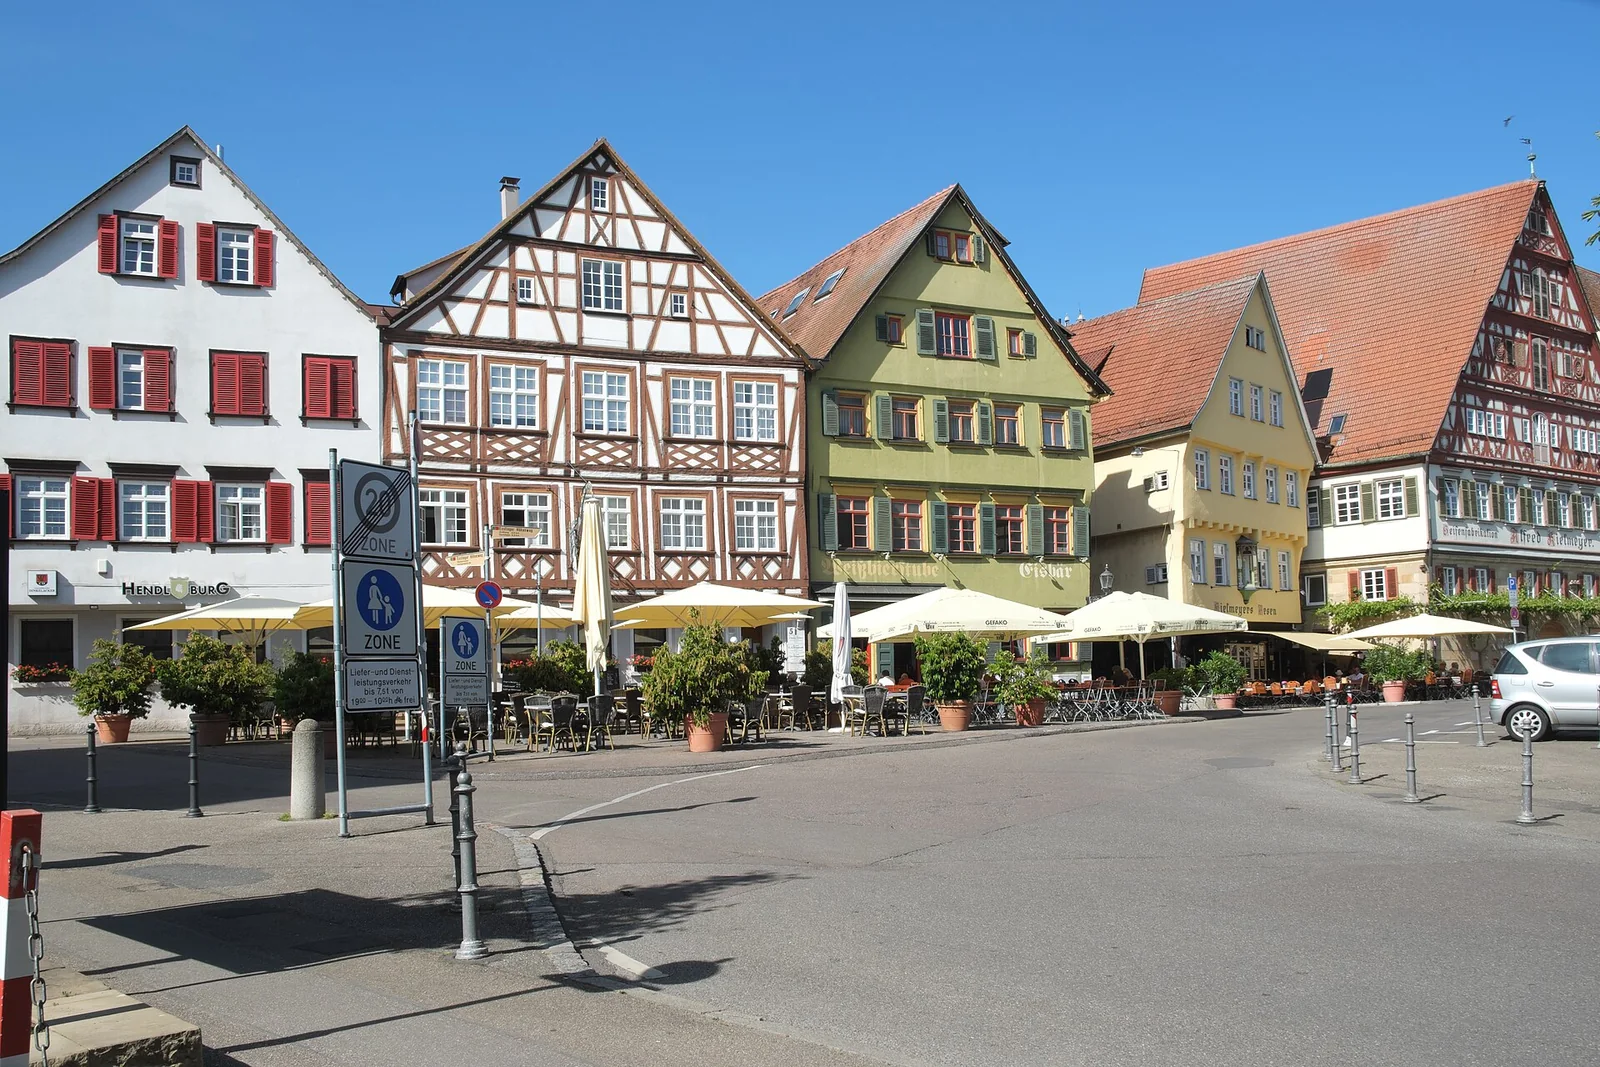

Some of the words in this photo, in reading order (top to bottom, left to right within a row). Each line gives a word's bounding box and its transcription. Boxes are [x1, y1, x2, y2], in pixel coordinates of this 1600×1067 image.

[1510, 527, 1541, 545] Alfred
[361, 536, 396, 554] ZONE
[1019, 562, 1073, 578] Eisbär
[122, 582, 170, 595] HENDL
[190, 582, 230, 595] BURG
[1509, 579, 1515, 589] P
[364, 634, 401, 650] ZONE
[389, 668, 414, 676] Dienst-
[455, 661, 477, 670] ZONE
[354, 678, 412, 687] leistungsverkehr
